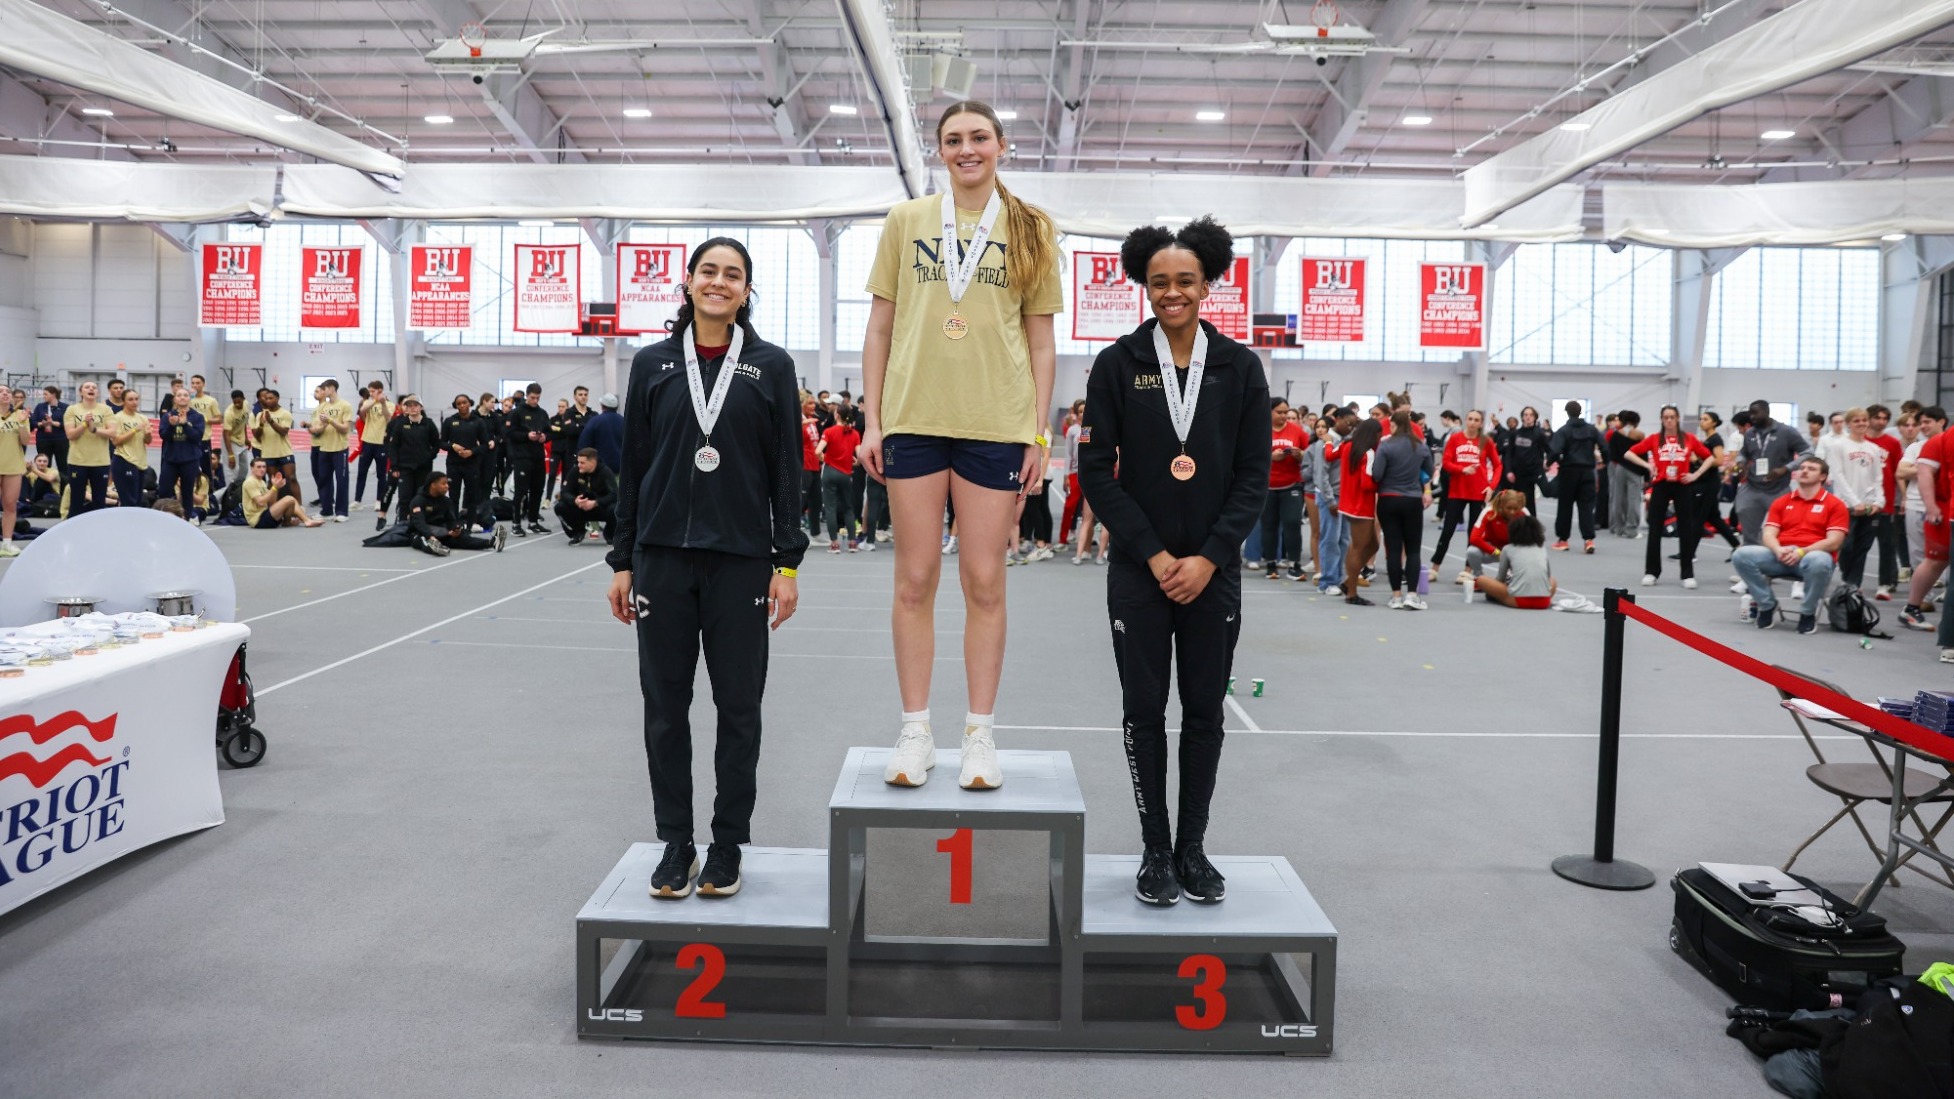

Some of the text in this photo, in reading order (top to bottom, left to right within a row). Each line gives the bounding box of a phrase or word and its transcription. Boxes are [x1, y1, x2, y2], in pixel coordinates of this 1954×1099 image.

[216, 247, 251, 274] BU
[315, 250, 350, 277] BU
[425, 248, 460, 276] BU
[531, 250, 566, 277] BU
[634, 249, 671, 277] BU
[917, 264, 947, 284] TRAC
[1315, 261, 1354, 289] BU
[210, 281, 254, 289] CONFERENCE
[1434, 267, 1472, 294] BU
[309, 284, 353, 293] CONFERENCE
[431, 283, 450, 291] NCAA
[206, 288, 257, 299] CHAMPIONS
[304, 292, 356, 303] CHAMPIONS
[412, 291, 470, 301] APPEARANCES
[521, 293, 574, 303] CHAMPIONS
[621, 294, 680, 303] APPEARANCES
[1085, 292, 1133, 300] CONFERENCE
[1081, 301, 1137, 311] CHAMPIONS
[1309, 296, 1357, 304] CONFERENCE
[1428, 301, 1476, 310] CONFERENCE
[1304, 304, 1361, 315] CHAMPIONS
[1423, 310, 1479, 321] CHAMPIONS
[735, 363, 762, 378] LGATE
[1135, 374, 1162, 385] ARMY
[0, 760, 129, 846] RIOT
[936, 828, 973, 904] 1
[675, 943, 726, 1018] 2
[1175, 954, 1227, 1030] 3
[588, 1008, 643, 1021] UCS
[1261, 1025, 1317, 1038] UCS
